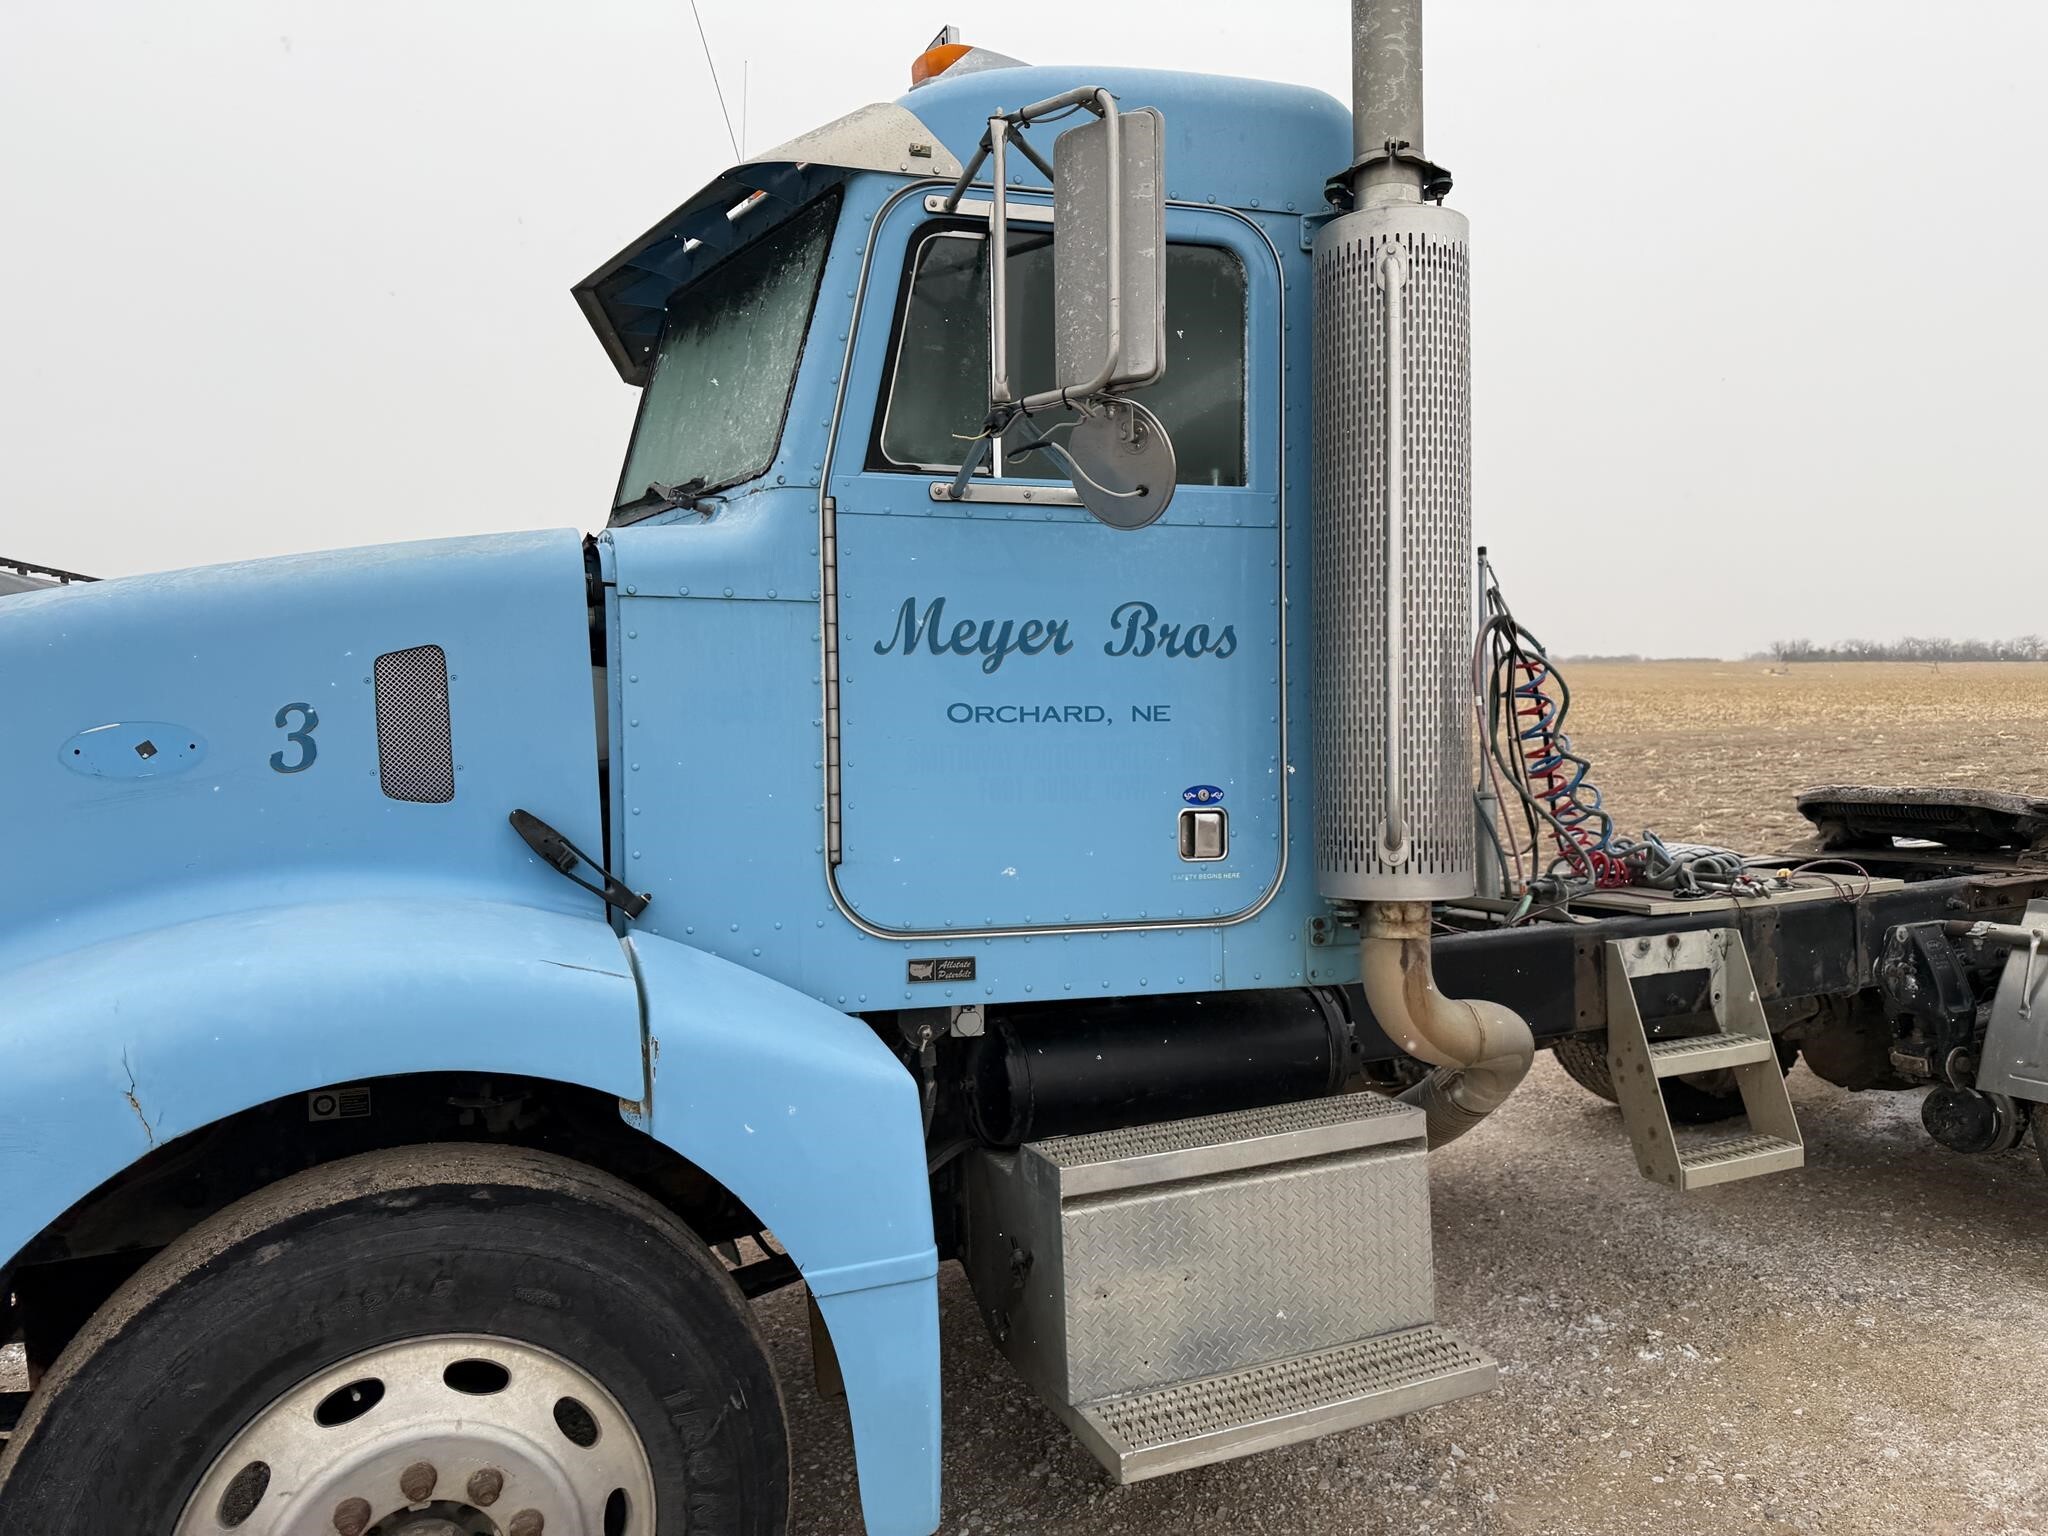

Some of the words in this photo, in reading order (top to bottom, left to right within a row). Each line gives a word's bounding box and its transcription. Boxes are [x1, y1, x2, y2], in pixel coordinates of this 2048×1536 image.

[873, 596, 1074, 674] Meyer
[1104, 601, 1238, 659] Bros
[269, 702, 319, 774] 3
[946, 702, 1113, 726] ORCHARD,
[1132, 705, 1171, 722] NE
